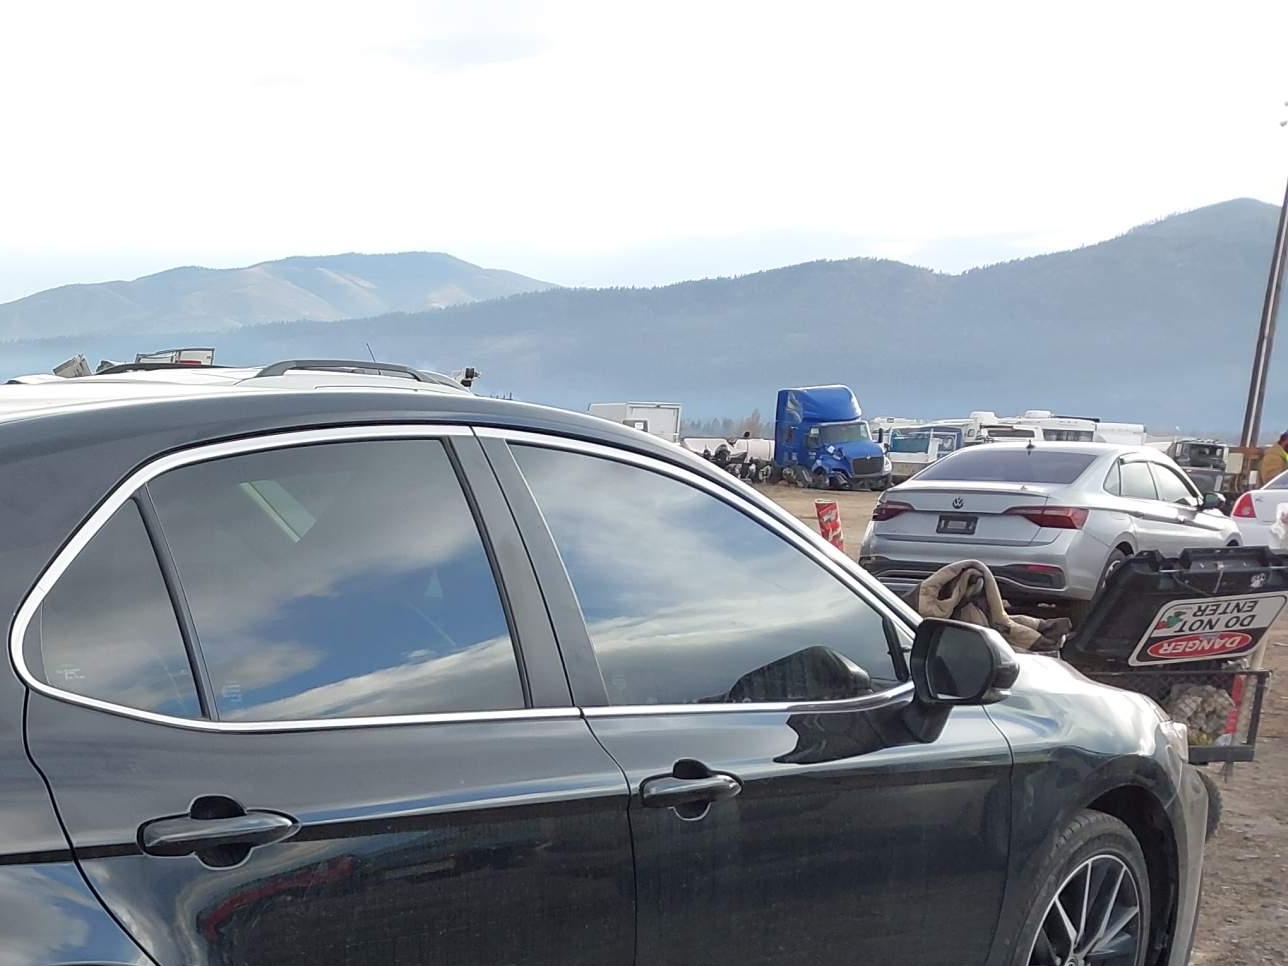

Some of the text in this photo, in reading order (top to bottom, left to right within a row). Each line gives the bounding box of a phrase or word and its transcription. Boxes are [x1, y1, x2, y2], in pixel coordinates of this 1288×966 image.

[1192, 600, 1259, 617] ENTER
[1174, 614, 1257, 633] DO NOT
[1159, 636, 1241, 654] DANGER
